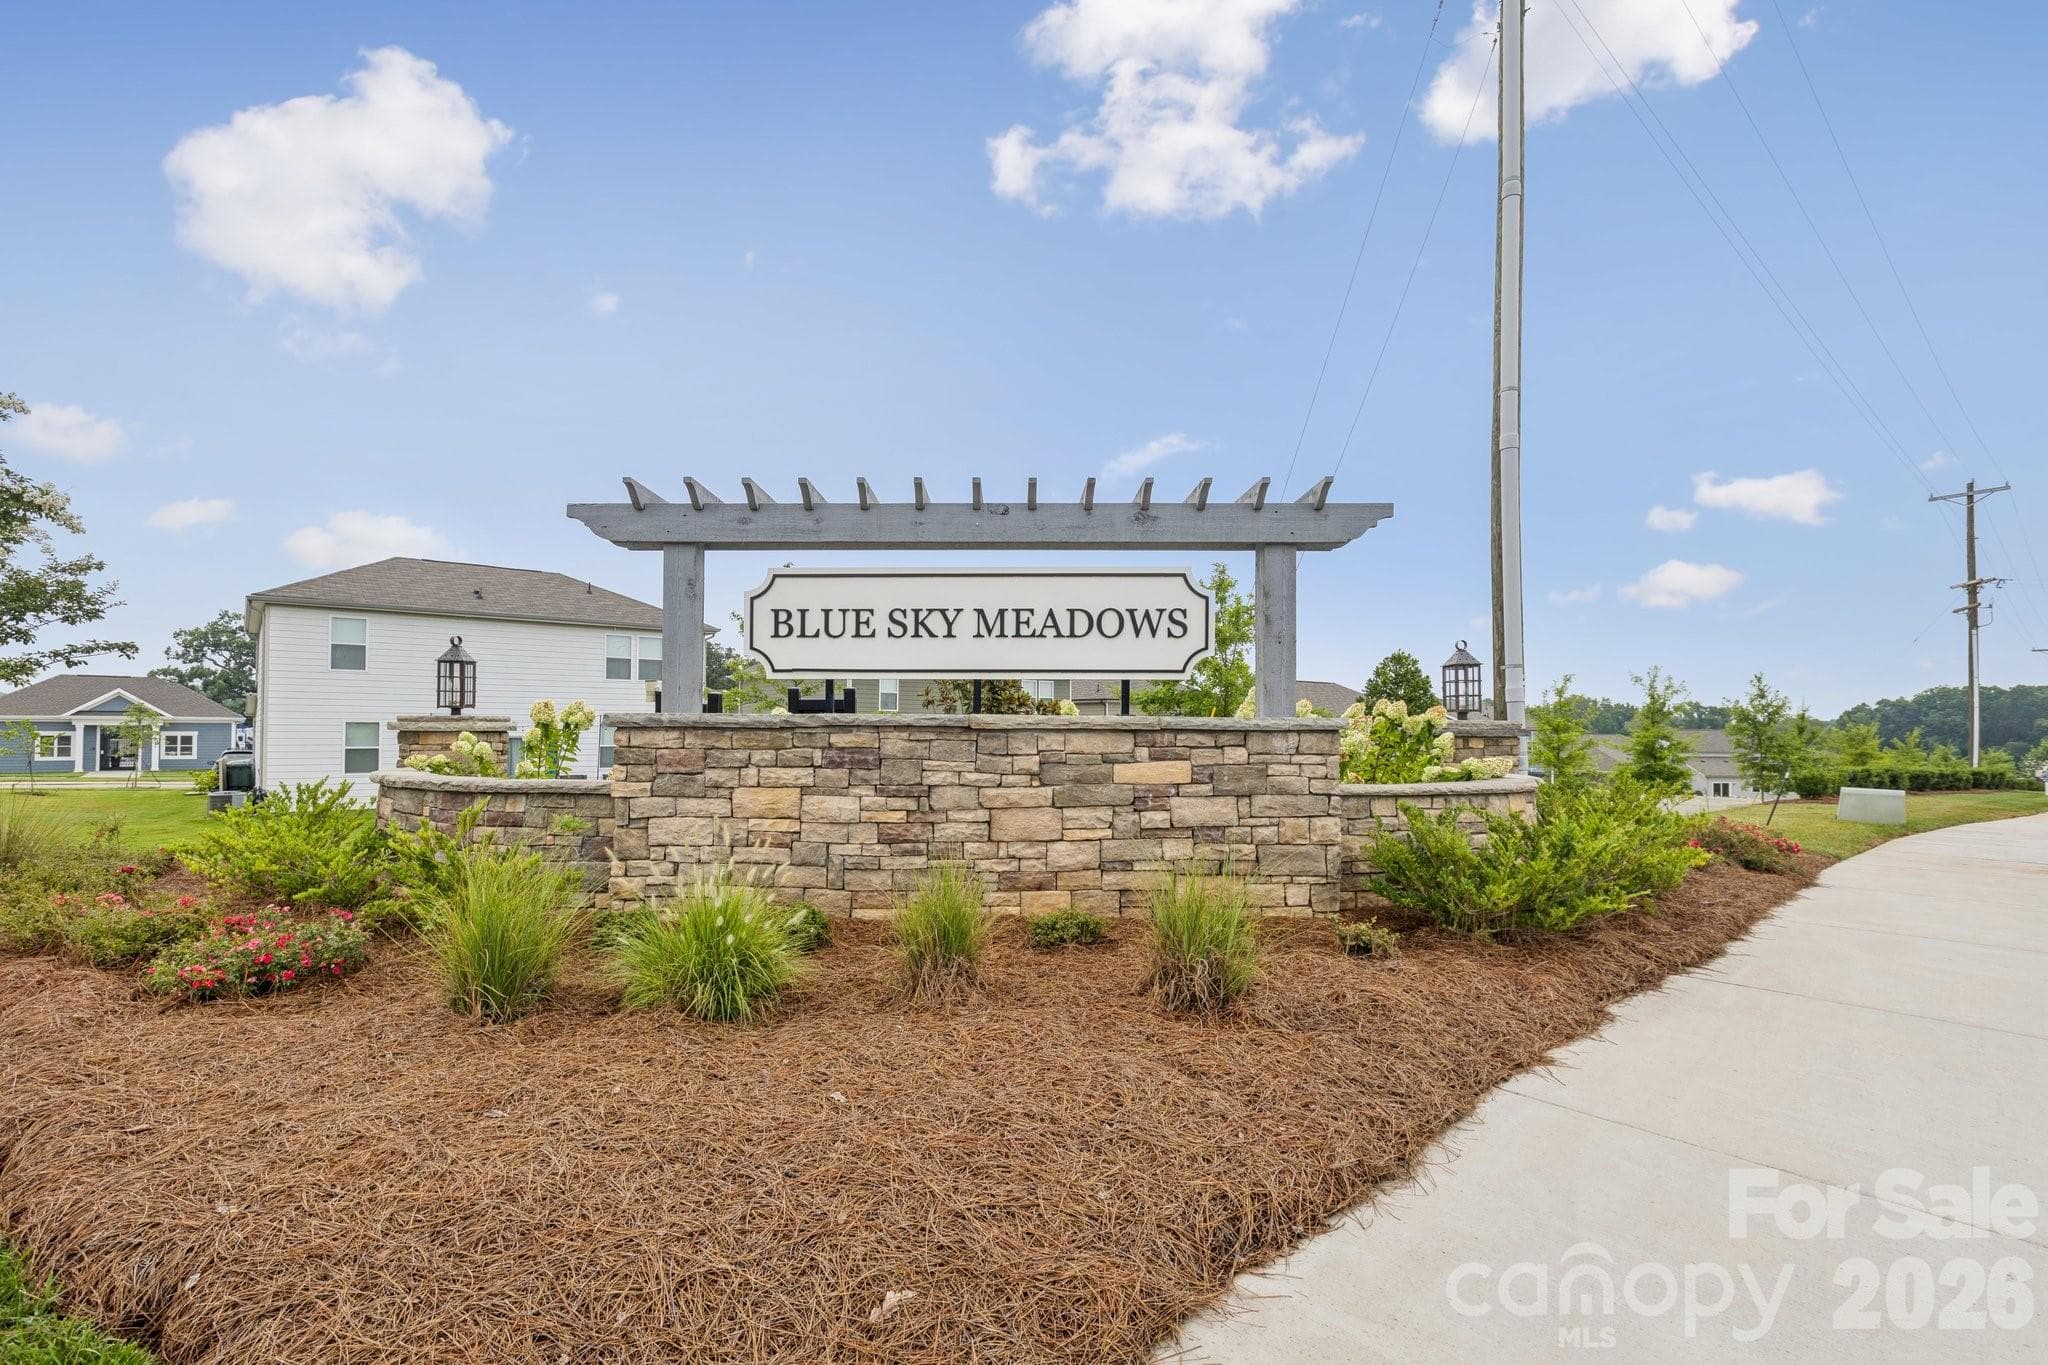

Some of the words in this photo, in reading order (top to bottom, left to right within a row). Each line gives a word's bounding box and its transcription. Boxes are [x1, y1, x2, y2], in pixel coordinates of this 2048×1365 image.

[770, 608, 876, 639] BLUE
[887, 607, 964, 639] SKY
[972, 607, 1188, 639] MEADOWS
